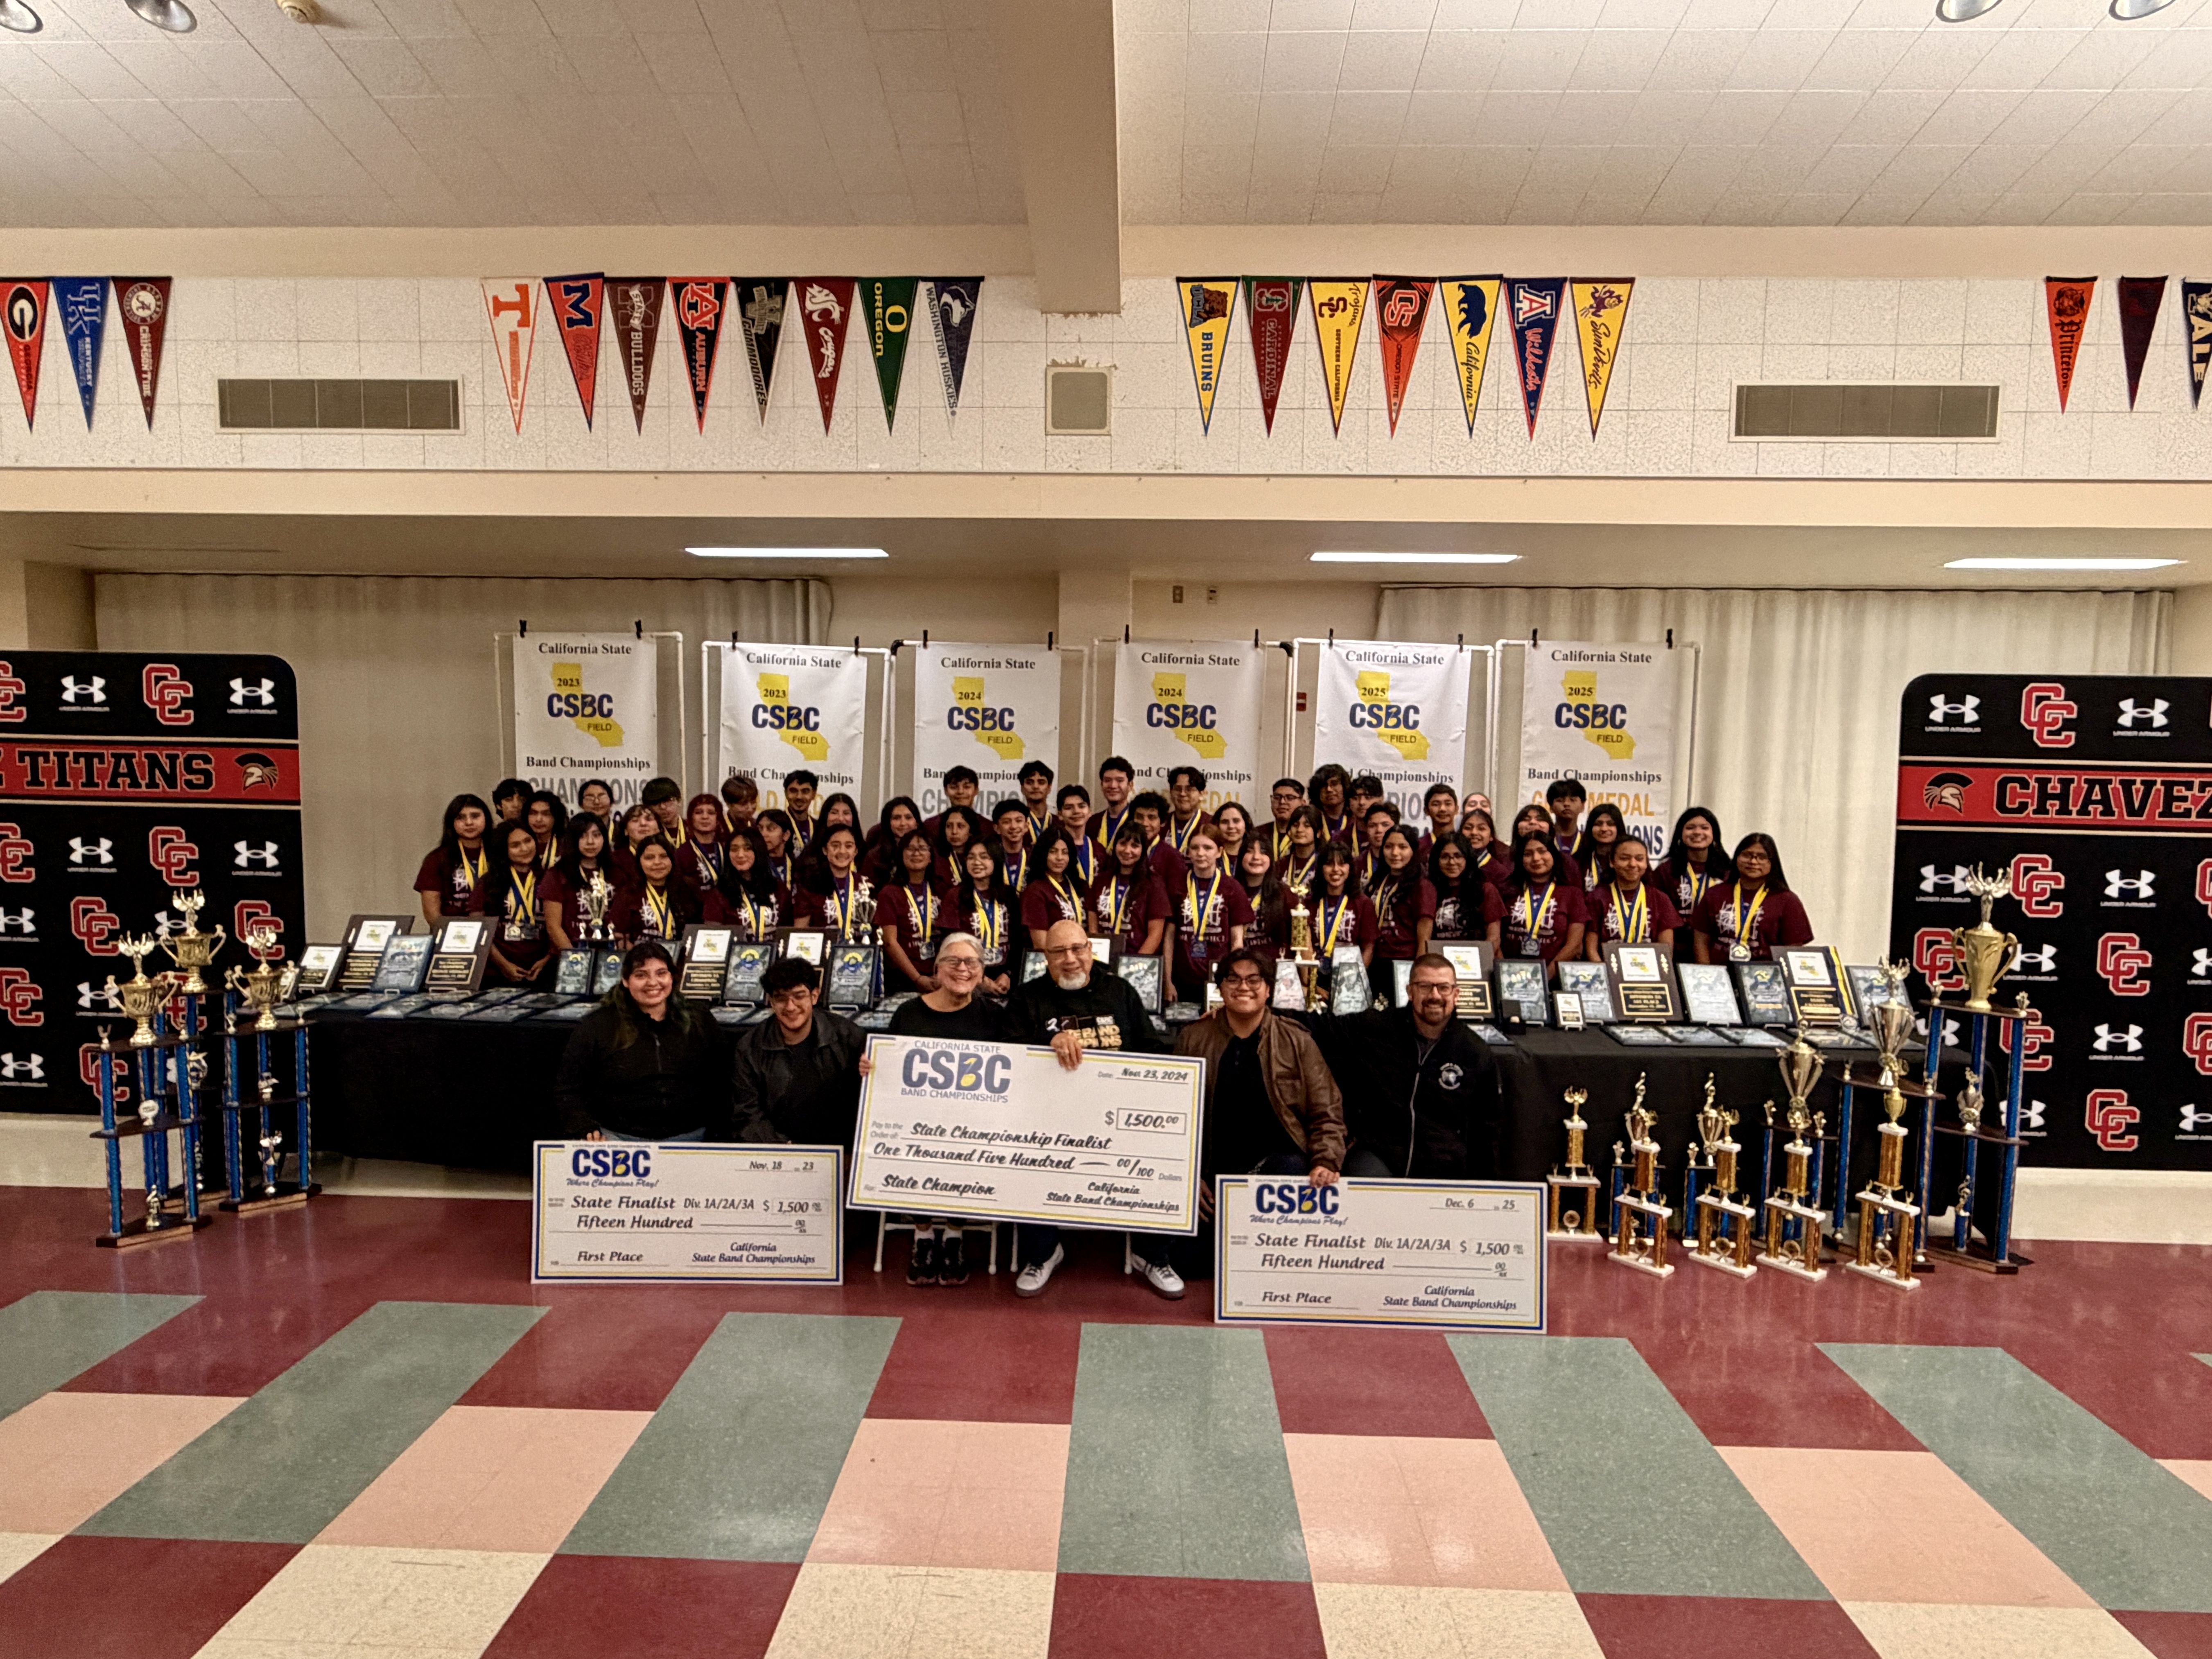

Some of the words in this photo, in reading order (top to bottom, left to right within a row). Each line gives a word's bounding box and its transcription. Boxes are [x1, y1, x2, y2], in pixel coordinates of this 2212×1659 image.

[492, 284, 531, 328] T
[563, 283, 594, 328] M
[631, 292, 644, 322] STATE
[1190, 284, 1204, 328] UCLA
[1349, 283, 1362, 327] Trojans
[1515, 283, 1556, 326] A
[13, 299, 34, 340] G
[874, 282, 884, 357] OREGON
[886, 305, 907, 333] O
[818, 327, 837, 378] Cougars
[926, 286, 948, 359] WASHINGTON
[940, 362, 958, 409] HUSKIES
[2055, 319, 2082, 390] Princeton
[84, 337, 93, 387] KENTUCKY
[630, 331, 644, 396] BULLDOGS
[696, 331, 706, 391] AUBURN
[742, 320, 766, 406] COMMODORES
[1201, 332, 1213, 392] BRUINS
[1265, 319, 1277, 400] CARDINAL
[1525, 328, 1543, 391] Wildcats
[1461, 342, 1481, 401] California
[539, 643, 598, 655] California
[601, 643, 632, 655] State
[1346, 650, 1409, 664] California
[1412, 653, 1444, 665] State
[1551, 650, 1616, 662] California
[1619, 651, 1652, 663] State
[746, 652, 807, 667] California
[811, 656, 842, 668] State
[941, 657, 1001, 669] California
[1005, 658, 1036, 669] State
[1141, 652, 1204, 665] California
[1208, 655, 1240, 667] State
[557, 678, 580, 687] 2023
[763, 688, 786, 698] 2023
[958, 692, 982, 701] 2024
[1158, 688, 1182, 697] 2024
[1361, 687, 1386, 696] 2025
[1568, 687, 1594, 696] 2025
[547, 693, 613, 718] CSBC
[752, 704, 820, 731] CSBC
[947, 706, 1015, 731] CSBC
[1147, 703, 1217, 729] CSBC
[1349, 703, 1420, 730] CSBC
[1555, 702, 1627, 729] CSBC
[587, 723, 612, 731] FIELD
[792, 736, 817, 745] FIELD
[987, 736, 1012, 744] FIELD
[1187, 734, 1213, 743] FIELD
[1390, 735, 1417, 744] FIELD
[1597, 734, 1623, 743] FIELD
[16, 749, 216, 793] TITANS
[526, 756, 556, 767] Band
[560, 756, 651, 771] Championships
[1528, 768, 1559, 780] Band
[1563, 769, 1662, 785] Championships
[914, 1040, 970, 1051] CALIFORNIA
[974, 1044, 1001, 1054] STATE
[902, 1048, 1012, 1094] CSBC
[1143, 1069, 1159, 1079] 23,
[1161, 1070, 1188, 1081] 2024
[901, 1087, 927, 1097] BAND
[930, 1089, 1009, 1103] CHAMPIONSHIPS
[1105, 1110, 1115, 1126] $
[910, 1122, 948, 1138] State
[951, 1125, 1053, 1148] Championship
[1054, 1133, 1112, 1150] Finalist
[572, 1149, 651, 1178] CSBC
[873, 1141, 902, 1156] One
[906, 1144, 977, 1162] Thousand
[977, 1150, 1007, 1164] Five
[1009, 1152, 1076, 1170] Hundred
[749, 1161, 769, 1170] Nov.
[773, 1161, 782, 1170] 18
[802, 1161, 814, 1170] 23
[881, 1174, 919, 1188] State
[922, 1177, 996, 1198] Champion
[1087, 1182, 1141, 1195] California
[571, 1196, 612, 1209] State
[618, 1196, 676, 1209] Finalist
[684, 1198, 701, 1209] Div.
[704, 1198, 754, 1209] 1A/2A/3A
[763, 1200, 770, 1212] $
[777, 1201, 809, 1213] 1,500
[1046, 1192, 1072, 1202] State
[1074, 1194, 1103, 1205] Band
[1103, 1197, 1179, 1213] Championships
[1256, 1184, 1340, 1215] CSBC
[1445, 1198, 1464, 1208] Dec.
[1467, 1199, 1474, 1208] 6
[1502, 1200, 1516, 1209] 25
[577, 1215, 625, 1230] Fifteen
[630, 1215, 693, 1229] Hundred
[730, 1242, 777, 1252] California
[1254, 1233, 1298, 1247] State
[1304, 1234, 1366, 1249] Finalist
[1374, 1237, 1393, 1249] Div.
[1396, 1238, 1451, 1251] 1A/2A/3A
[1460, 1241, 1467, 1253] $
[1475, 1242, 1510, 1256] 1,500
[577, 1251, 605, 1261] First
[609, 1251, 644, 1262] Place
[692, 1253, 716, 1262] State
[719, 1254, 743, 1263] Band
[746, 1254, 815, 1265] Championships
[1261, 1254, 1313, 1269] Fifteen
[1317, 1254, 1385, 1270] Hundred
[1262, 1291, 1290, 1302] First
[1296, 1292, 1332, 1304] Place
[1424, 1286, 1475, 1297] California
[1383, 1296, 1409, 1306] State
[1412, 1297, 1439, 1307] Band
[1442, 1297, 1516, 1311] Championships
